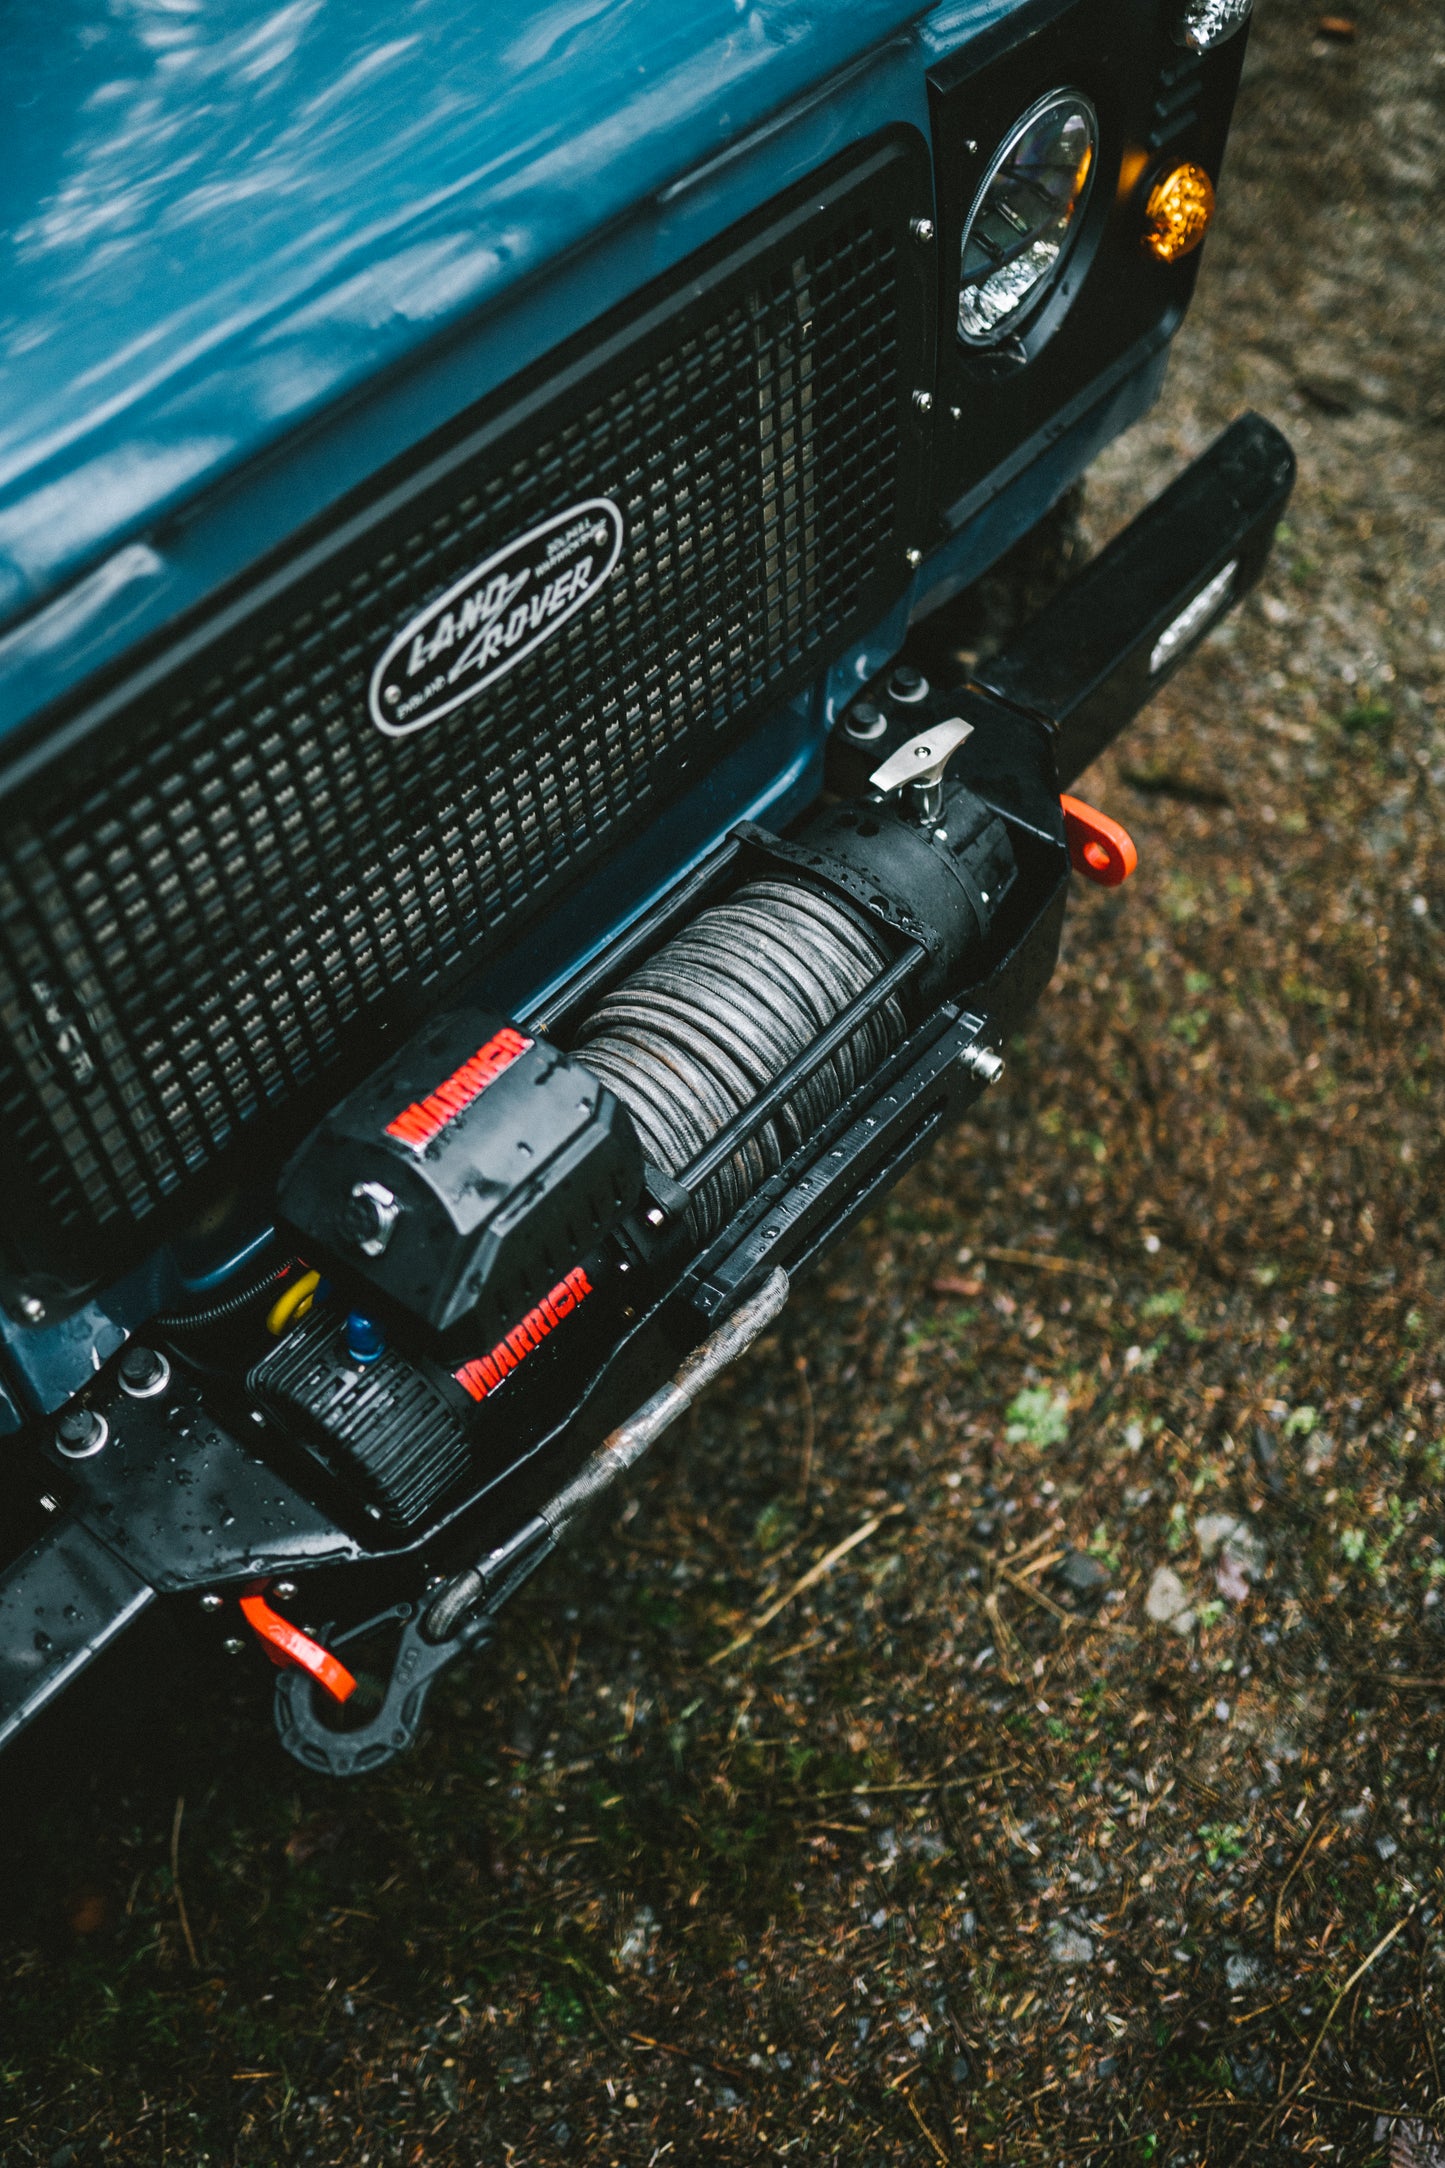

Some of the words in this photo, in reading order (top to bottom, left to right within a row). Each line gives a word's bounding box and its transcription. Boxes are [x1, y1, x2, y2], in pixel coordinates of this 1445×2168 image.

[406, 571, 512, 677] LAND
[474, 555, 594, 669] ROVER
[384, 1027, 533, 1150] WARRIOR
[454, 1265, 594, 1404] WARRIOR
